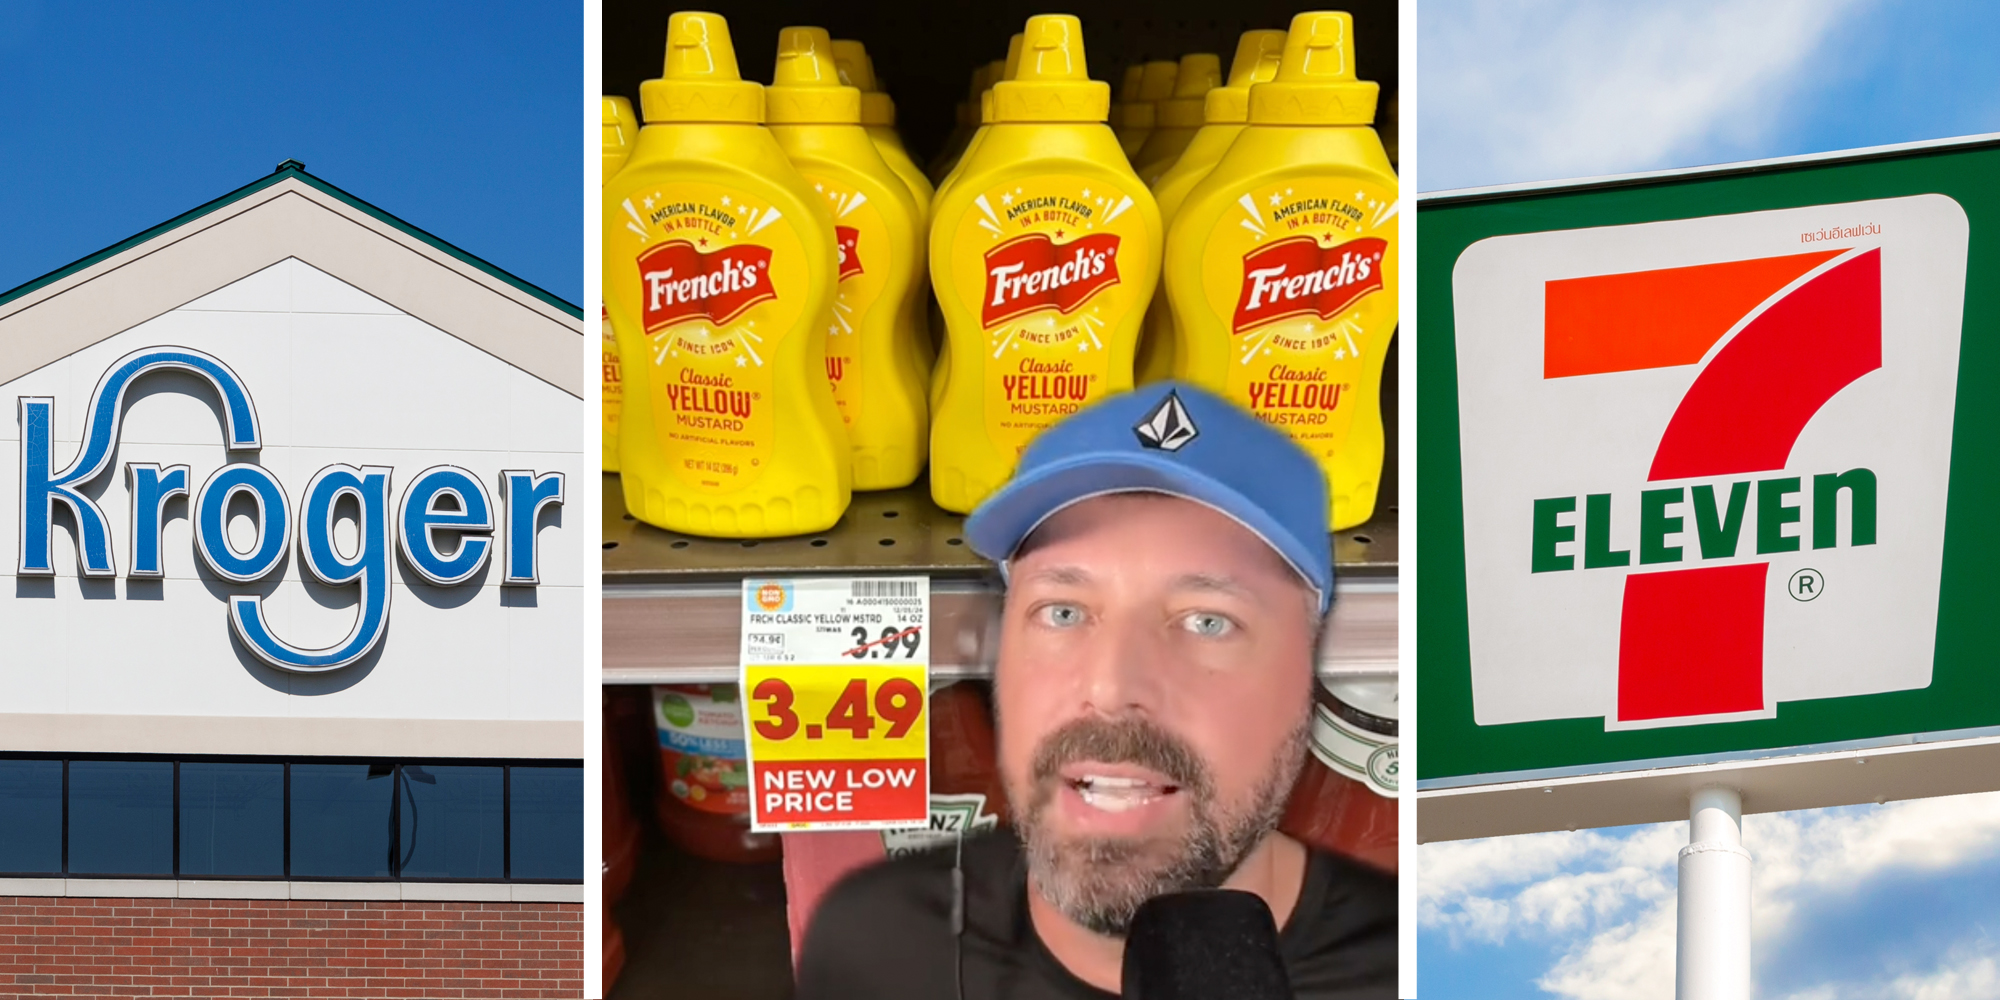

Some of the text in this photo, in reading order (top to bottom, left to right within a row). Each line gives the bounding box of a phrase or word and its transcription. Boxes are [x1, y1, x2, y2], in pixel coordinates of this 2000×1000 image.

[650, 202, 736, 227] AMERICAN FLAVOR
[1006, 197, 1093, 221] AMERICAN FLAVOR
[1273, 199, 1363, 222] AMERICAN FLAVOR
[663, 217, 723, 236] IN A BOTTLE
[1020, 210, 1080, 228] IN A BOTTLE
[1287, 213, 1349, 231] IN A BOTTLE
[1019, 328, 1051, 343] SINCE
[1272, 334, 1306, 349] SINCE
[677, 337, 706, 354] SINCE
[1019, 357, 1074, 374] Classic
[1268, 364, 1327, 381] Classic
[680, 367, 733, 387] Classic
[1003, 374, 1088, 401] YELLOW
[1249, 382, 1341, 411] YELLOW
[667, 383, 751, 419] YELLOW
[1010, 402, 1080, 415] MUSTARD
[676, 413, 744, 432] MUSTARD
[680, 434, 719, 445] ARTIFICIAL
[720, 438, 755, 448] FLAVORS
[17, 345, 566, 675] Kroger
[750, 614, 774, 624] FRCH
[776, 614, 812, 624] CLASSIC
[813, 614, 851, 624] YELLOW
[853, 614, 882, 624] MSTRD
[909, 613, 923, 623] OZ
[851, 626, 921, 659] 3.99
[752, 677, 924, 741] 3.49
[764, 768, 916, 790] NEW LOW
[766, 791, 854, 813] PRICE
